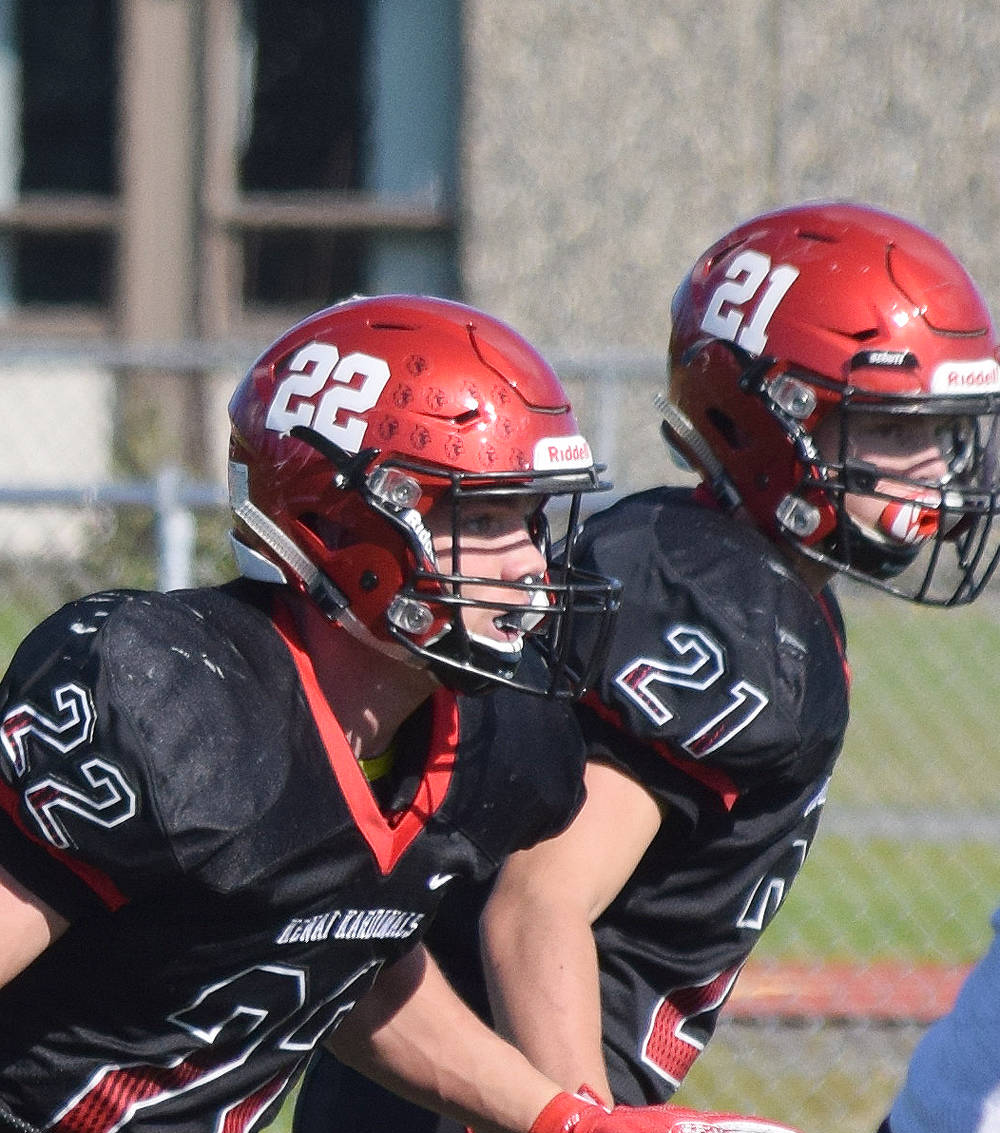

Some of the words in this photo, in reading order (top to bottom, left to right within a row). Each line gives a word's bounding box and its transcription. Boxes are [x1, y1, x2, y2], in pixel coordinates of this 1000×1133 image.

[701, 250, 800, 357] 21
[265, 343, 391, 454] 22
[615, 625, 769, 759] 21
[0, 682, 136, 850] 22
